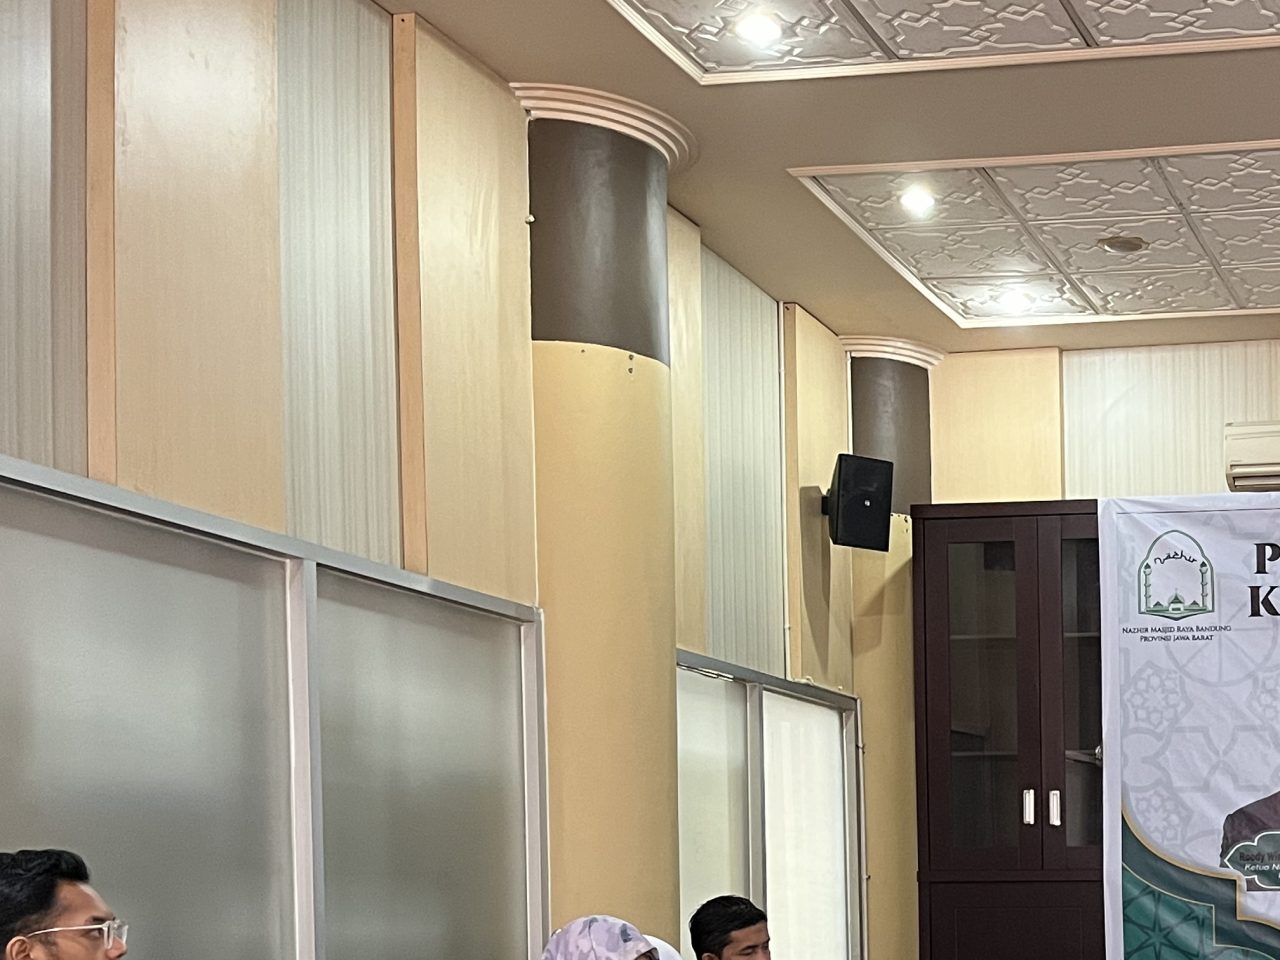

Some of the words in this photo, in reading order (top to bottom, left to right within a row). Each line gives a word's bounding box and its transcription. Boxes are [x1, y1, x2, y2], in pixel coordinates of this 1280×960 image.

[1150, 626, 1175, 634] MASJID
[1176, 625, 1194, 633] RAYA
[1195, 625, 1232, 633] BANDUNG
[1173, 634, 1190, 642] JAWA
[1244, 863, 1270, 871] Ketua
